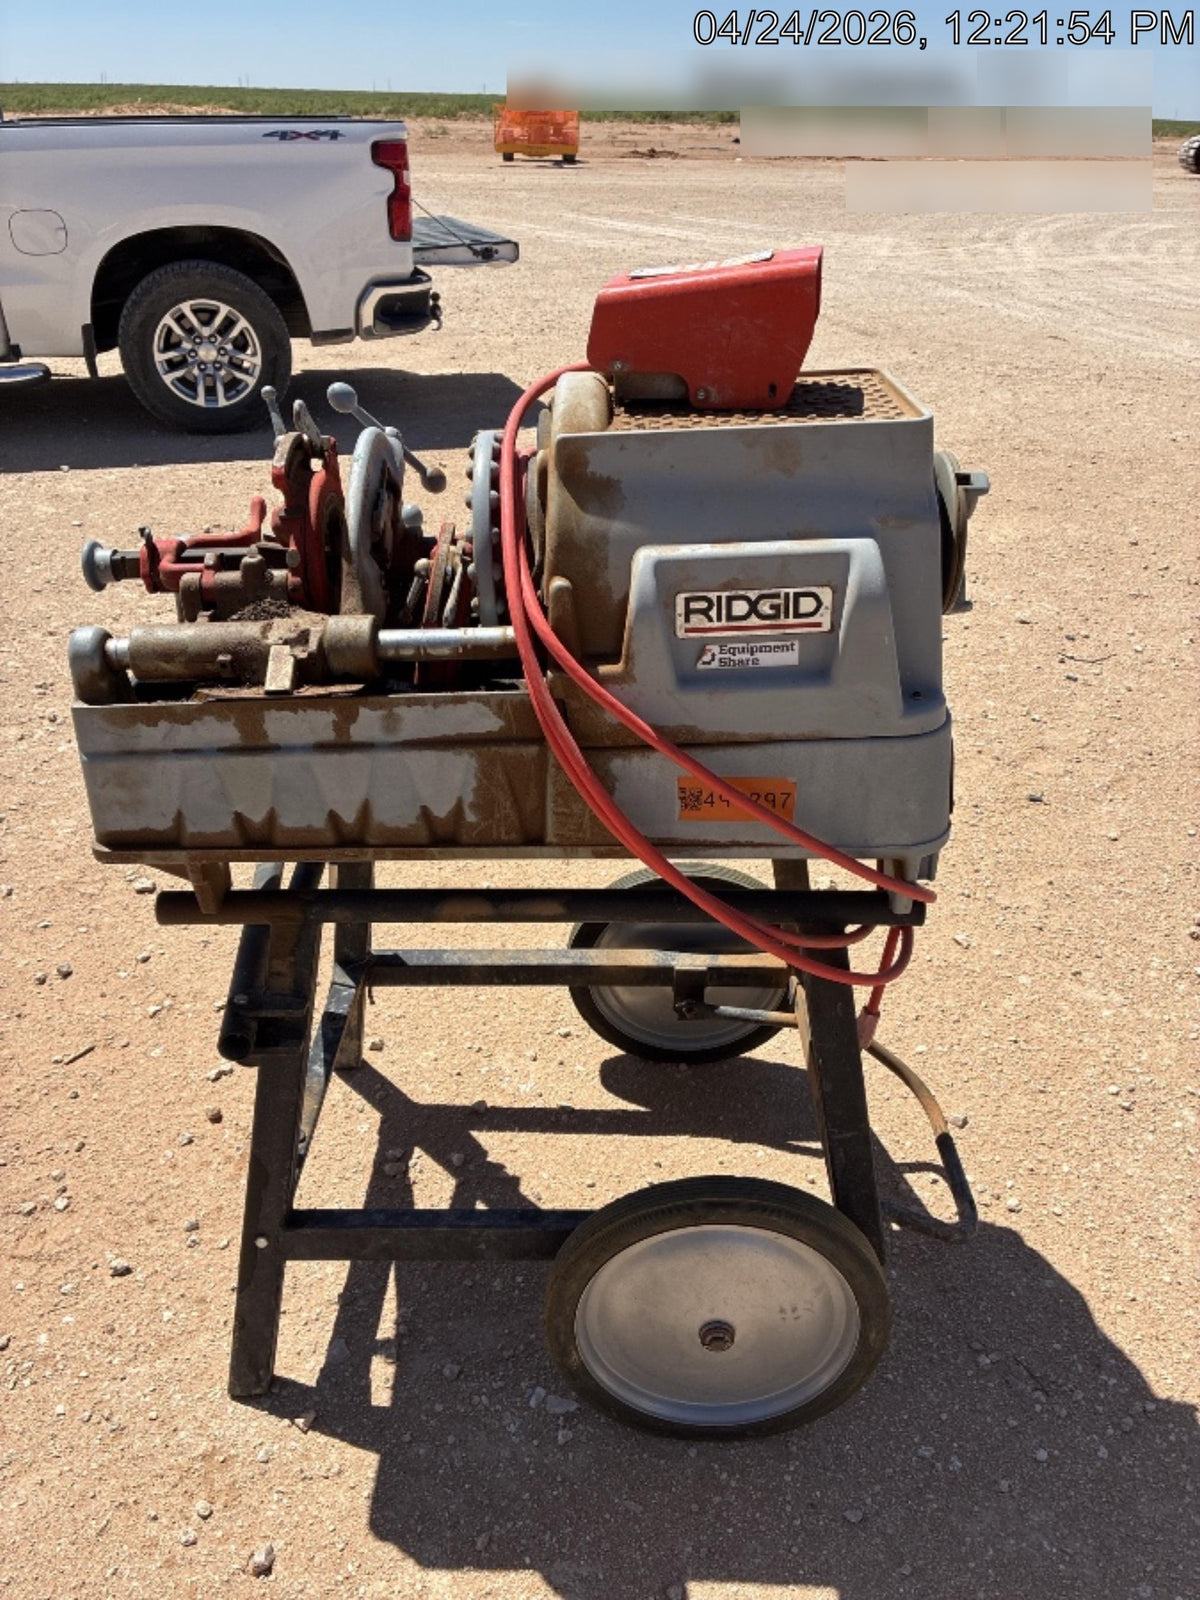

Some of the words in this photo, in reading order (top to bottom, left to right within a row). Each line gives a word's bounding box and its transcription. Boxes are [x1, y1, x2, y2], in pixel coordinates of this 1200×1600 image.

[683, 591, 824, 623] RIDGID
[718, 641, 796, 657] Equipment
[718, 656, 761, 668] Share
